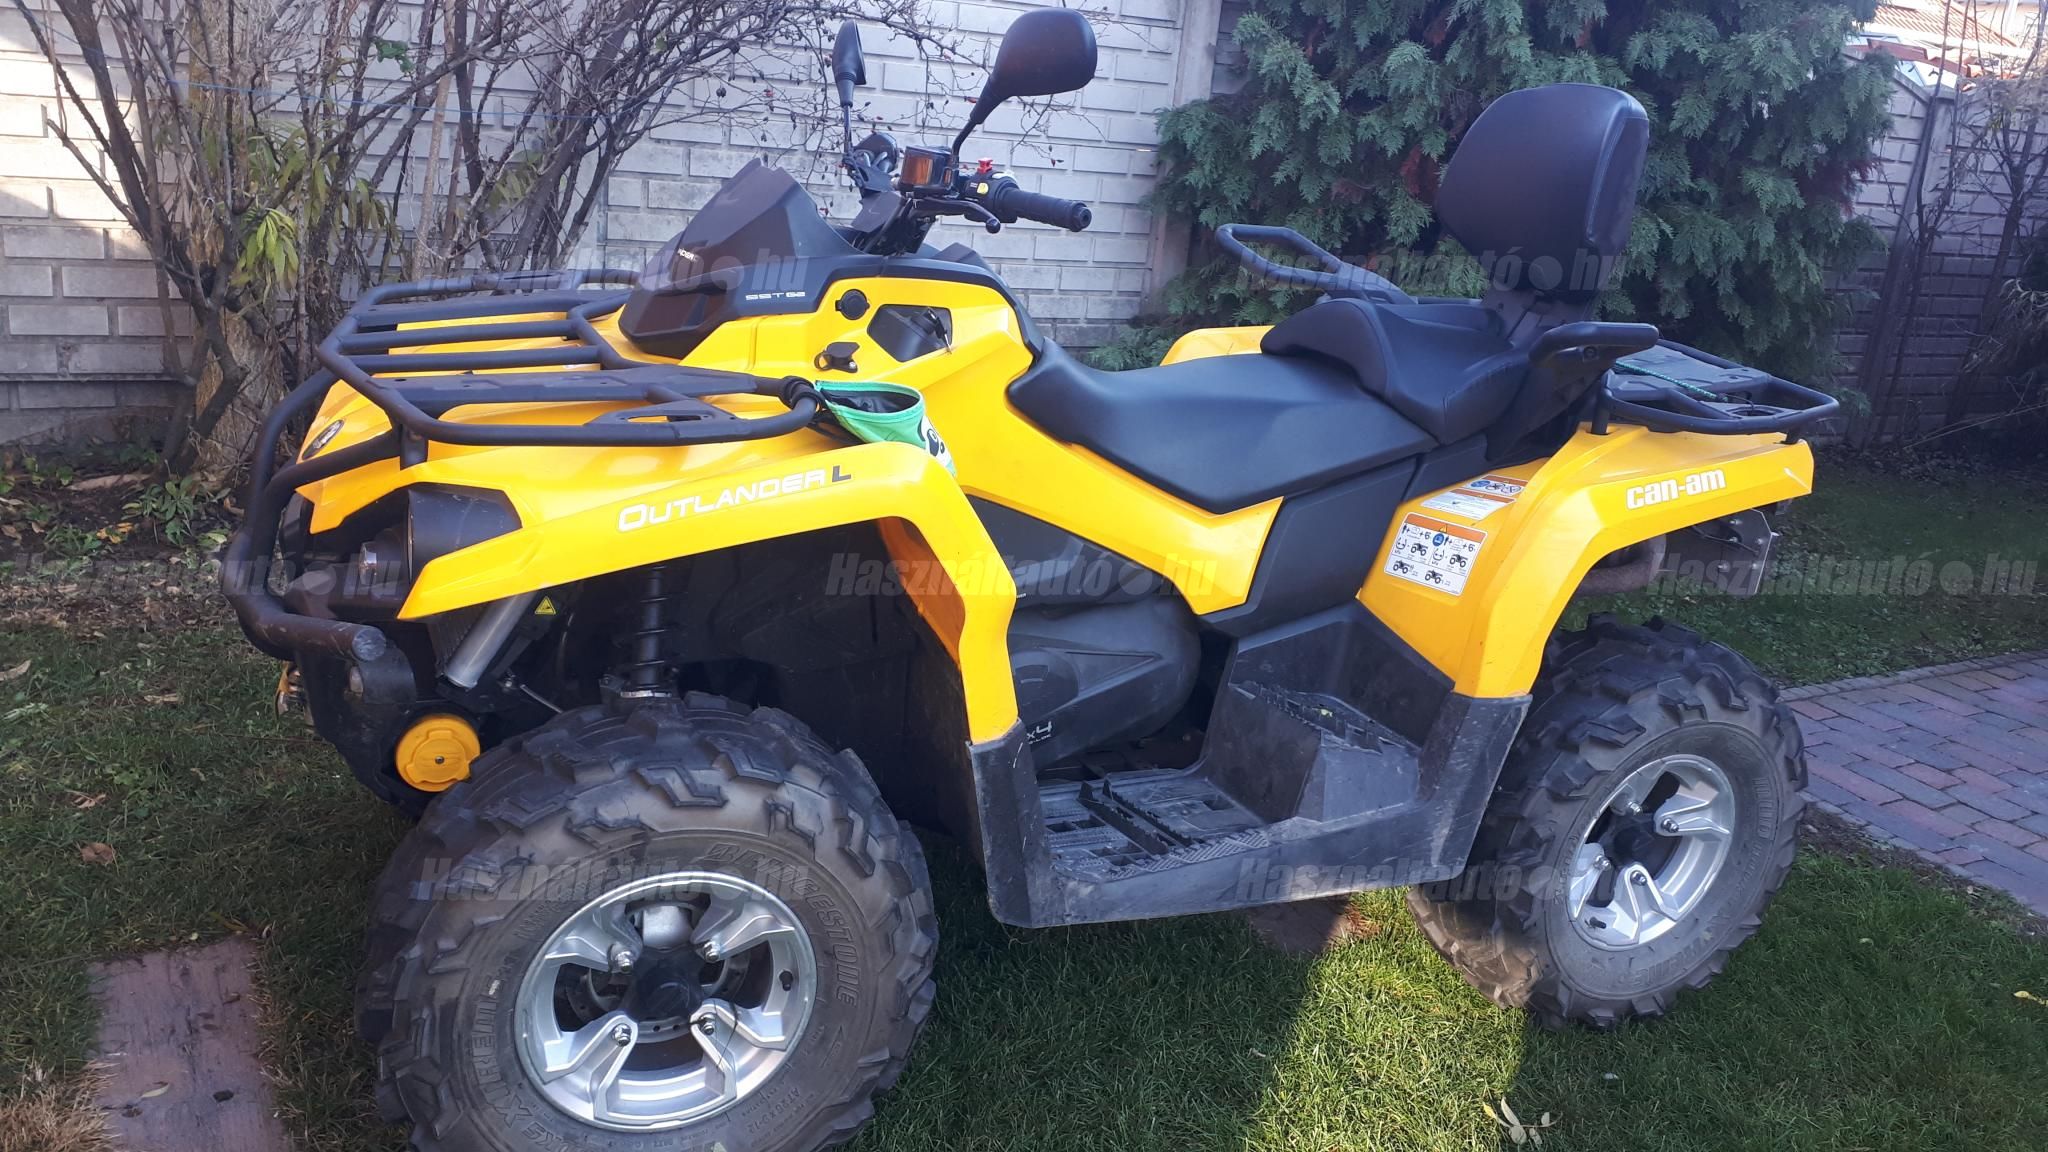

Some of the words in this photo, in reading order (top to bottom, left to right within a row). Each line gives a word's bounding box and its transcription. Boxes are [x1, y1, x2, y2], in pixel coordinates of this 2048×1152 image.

[617, 467, 826, 533] OUTLANDER
[832, 465, 852, 482] L
[1626, 468, 1726, 510] can-am
